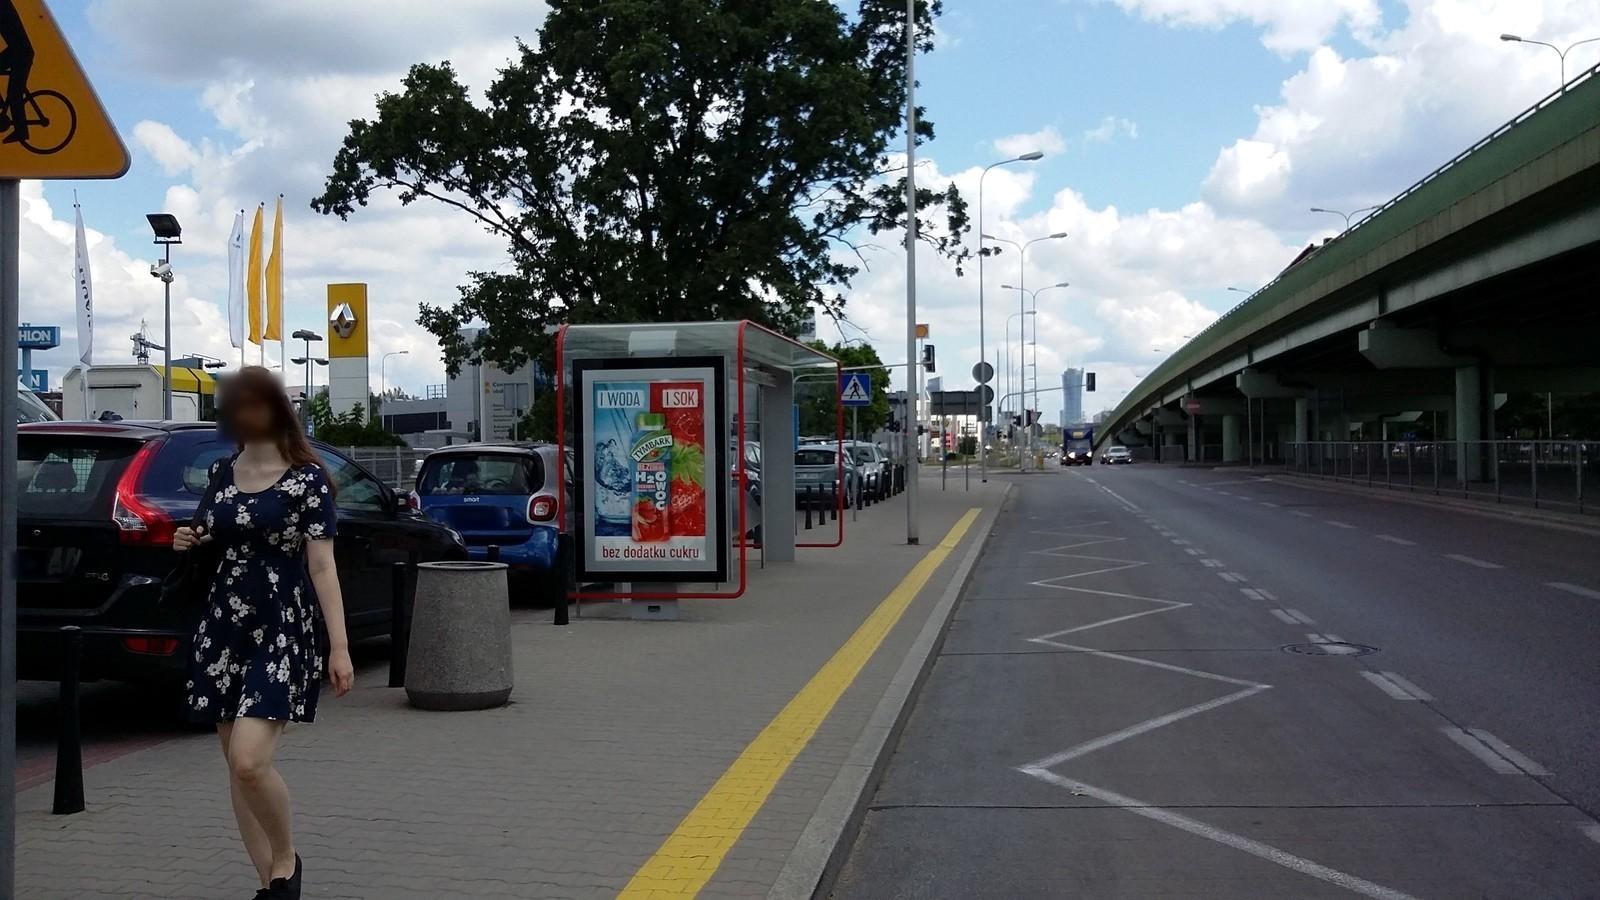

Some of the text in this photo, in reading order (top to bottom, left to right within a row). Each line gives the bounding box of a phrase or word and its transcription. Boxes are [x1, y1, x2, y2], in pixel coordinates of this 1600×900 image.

[606, 391, 640, 407] WODA
[673, 391, 696, 406] SOK
[633, 435, 672, 460] TYMBARK
[602, 546, 699, 559] bez dodatku cukru
